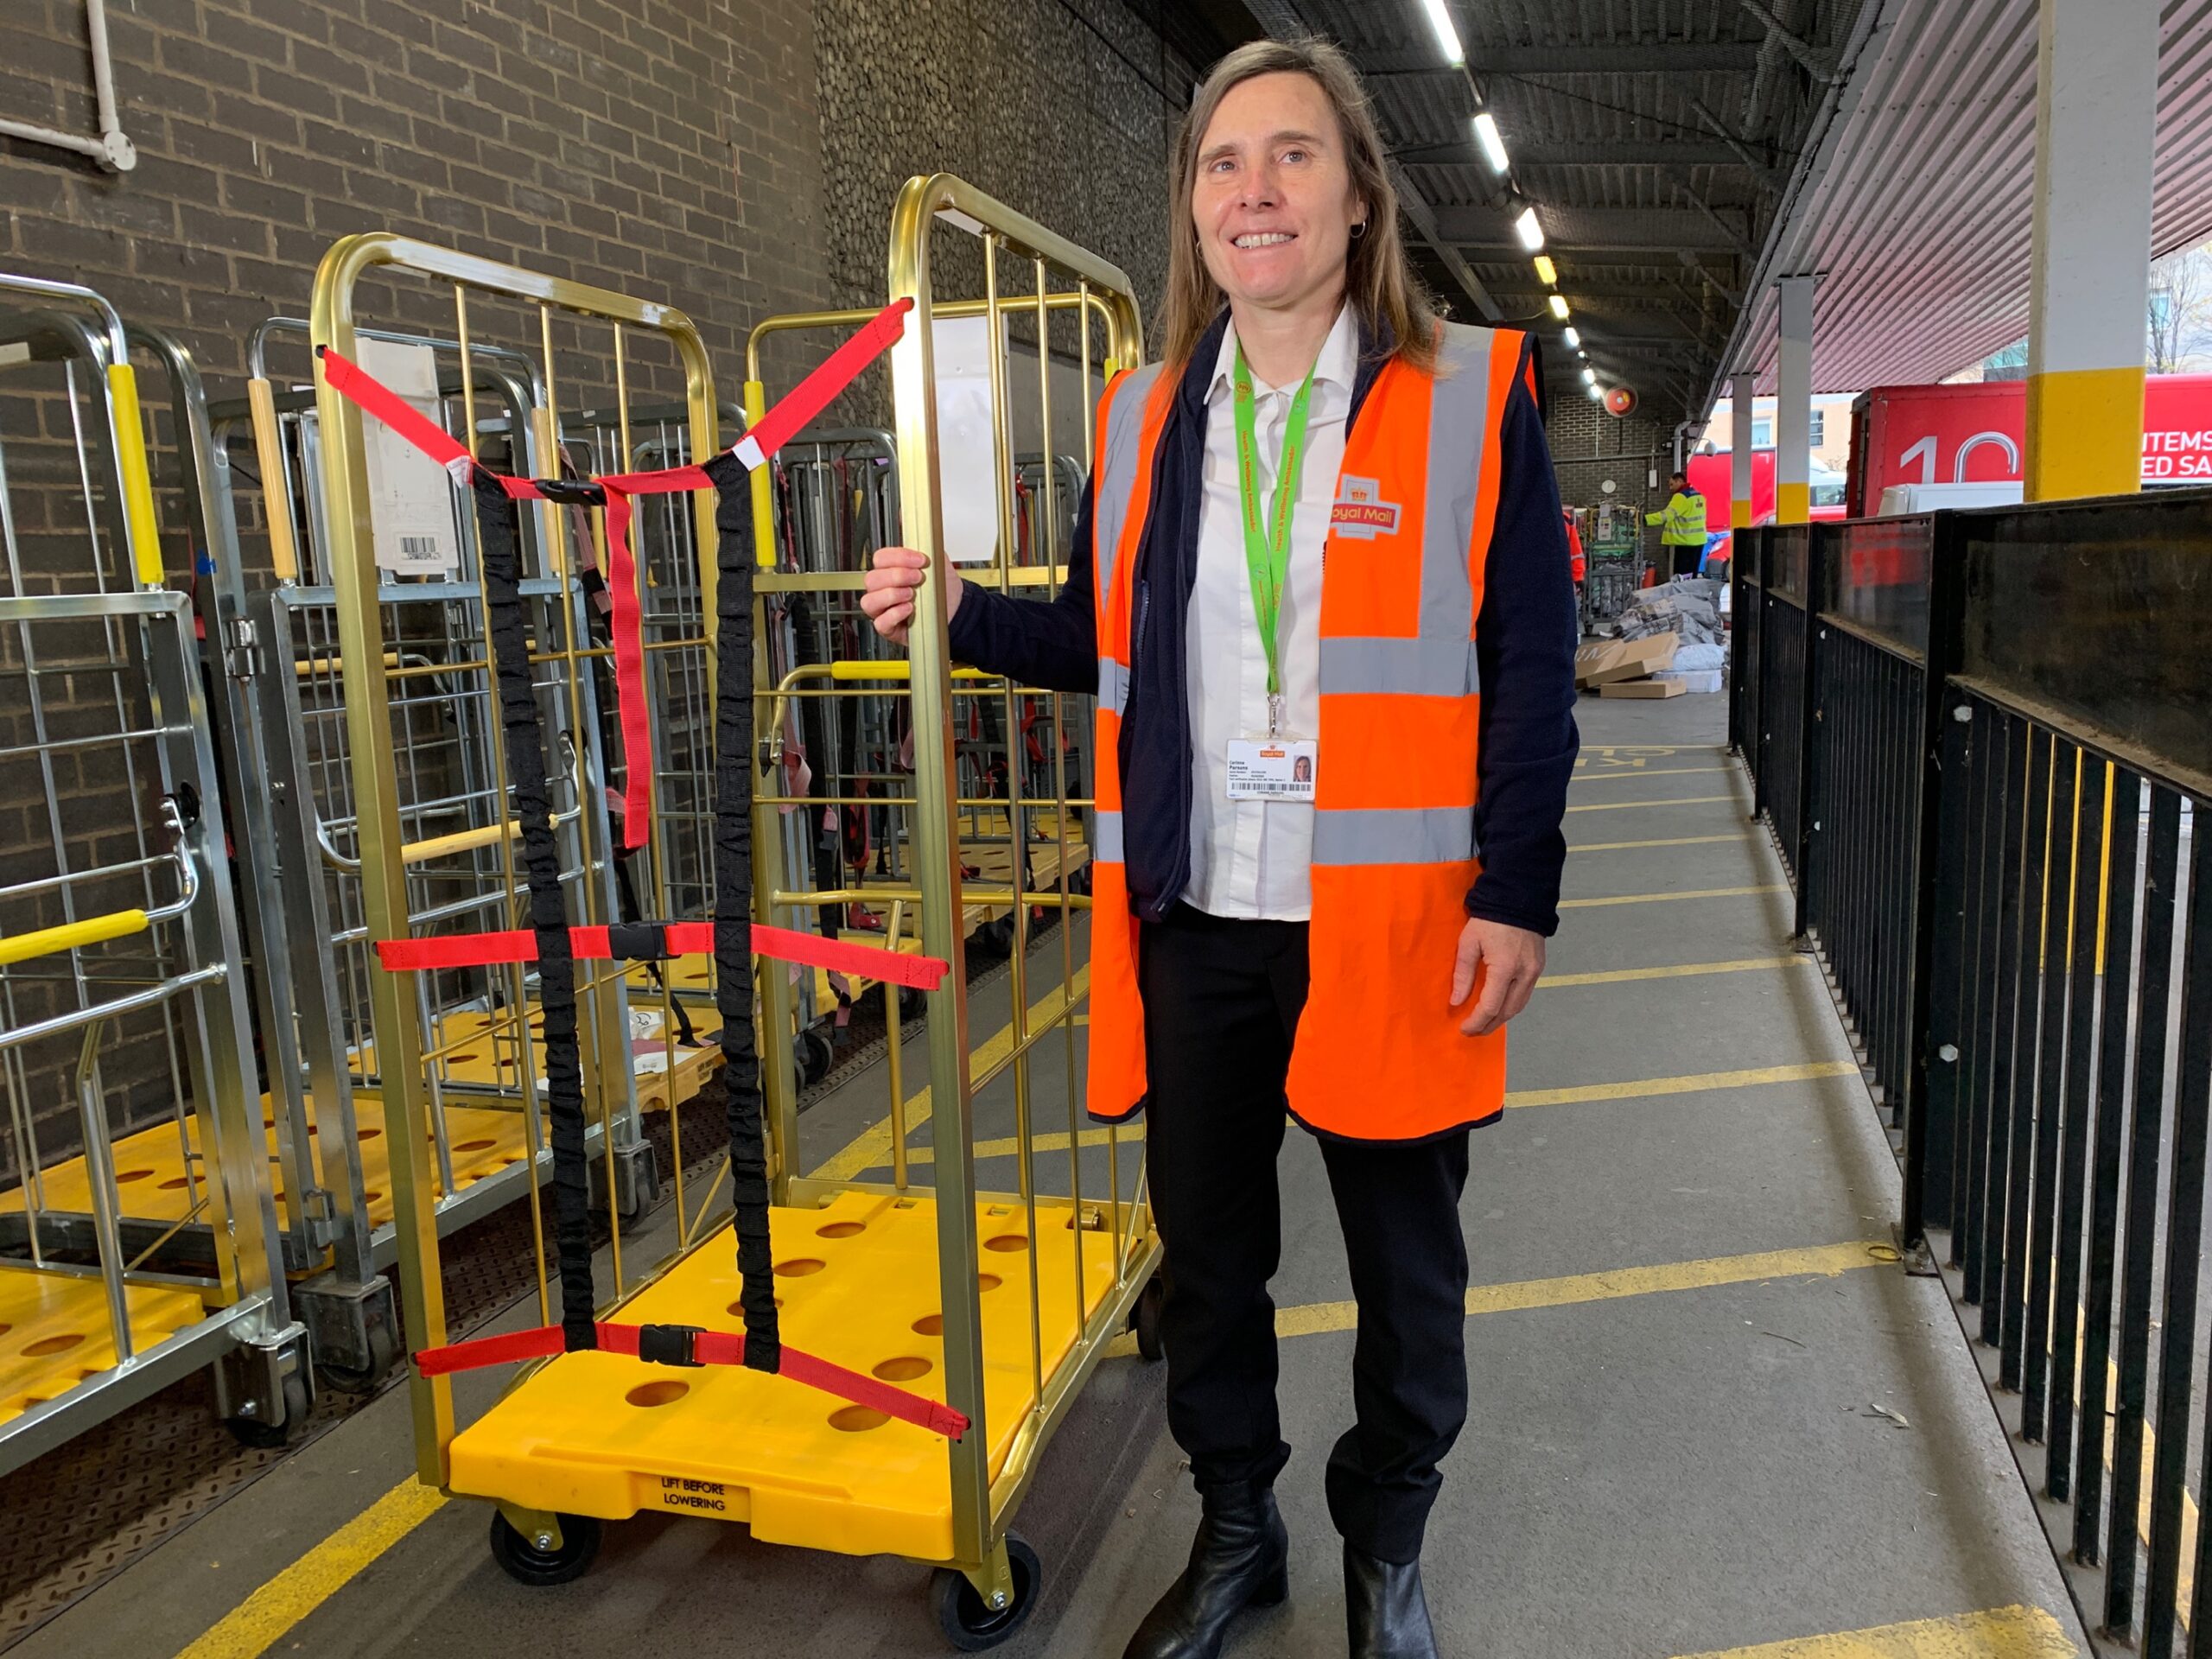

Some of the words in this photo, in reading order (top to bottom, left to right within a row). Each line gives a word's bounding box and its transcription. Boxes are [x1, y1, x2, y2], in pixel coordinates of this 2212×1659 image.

[2143, 430, 2212, 453] ITEMS
[1332, 507, 1362, 520] oyal
[1363, 508, 1393, 524] Mail
[662, 1478, 679, 1488] LIFT
[683, 1480, 724, 1495] BEFORE
[664, 1493, 726, 1511] LOWERING
